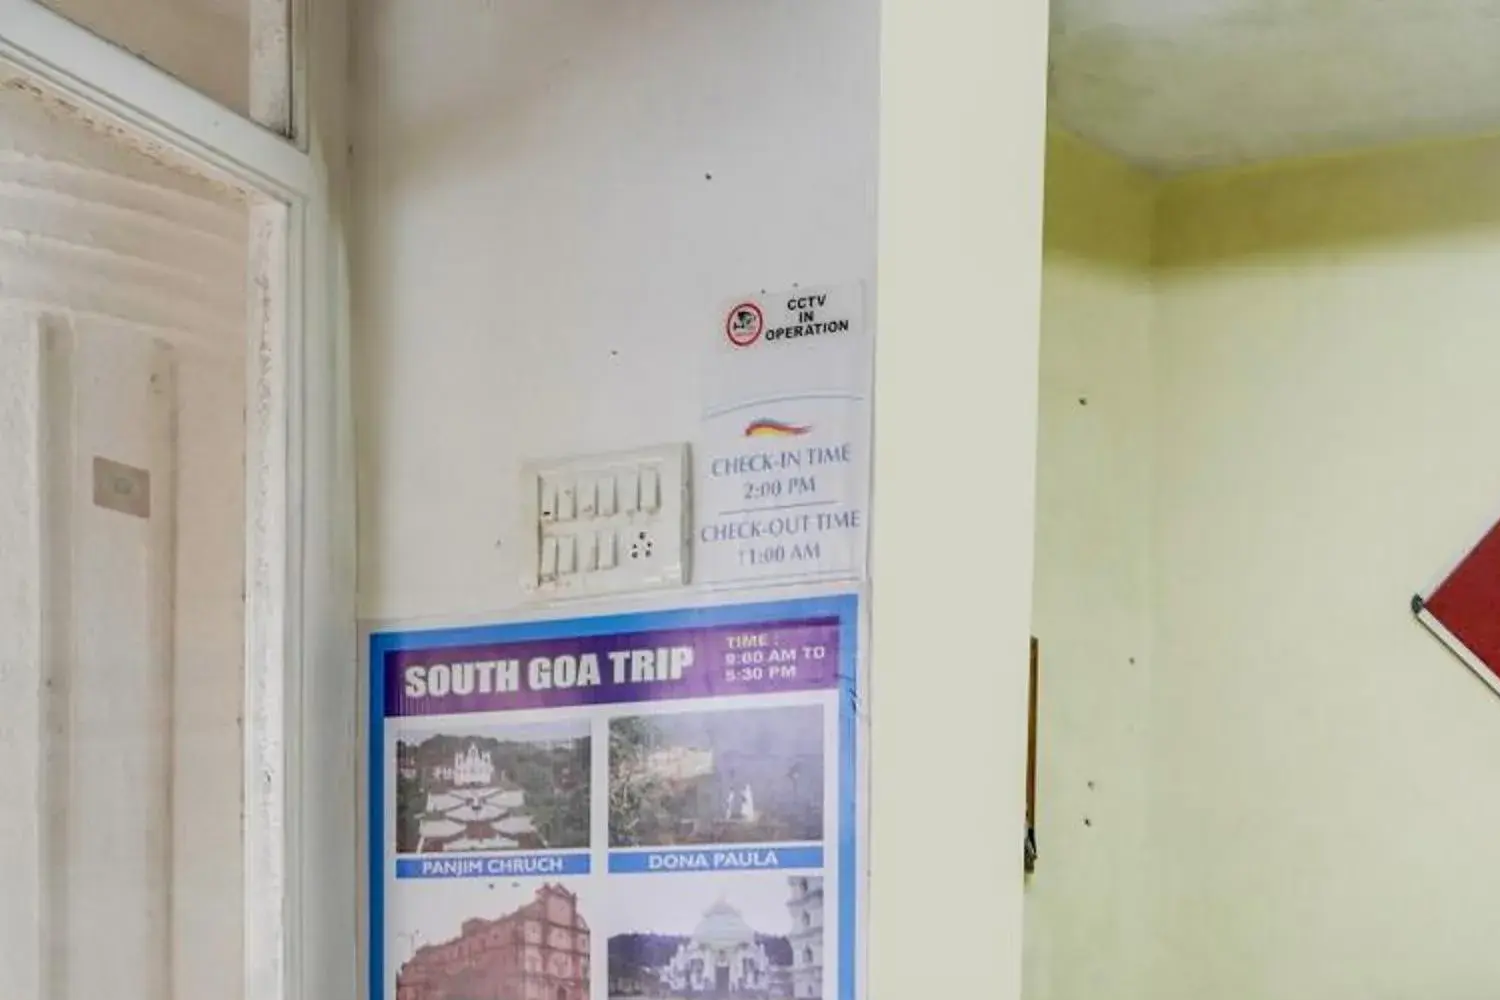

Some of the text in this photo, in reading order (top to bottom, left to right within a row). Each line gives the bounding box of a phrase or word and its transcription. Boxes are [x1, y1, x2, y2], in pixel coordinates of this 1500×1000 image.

[787, 295, 826, 311] CCTV
[799, 311, 814, 323] IN
[765, 320, 849, 341] OPERATION
[711, 443, 851, 477] CHECK-IN TIME
[744, 476, 816, 499] 2:00 PM
[701, 510, 861, 543] CHECK-OUT TIME
[738, 542, 820, 566] 11:00 AM
[726, 633, 768, 649] TIME
[768, 648, 797, 662] AM
[802, 645, 826, 660] TO
[404, 646, 694, 698] SOUTH GOA TRIP
[725, 665, 797, 682] 5:30 PM
[422, 856, 564, 877] PANJIM CHRUCH
[648, 850, 779, 870] DONA PAULA
